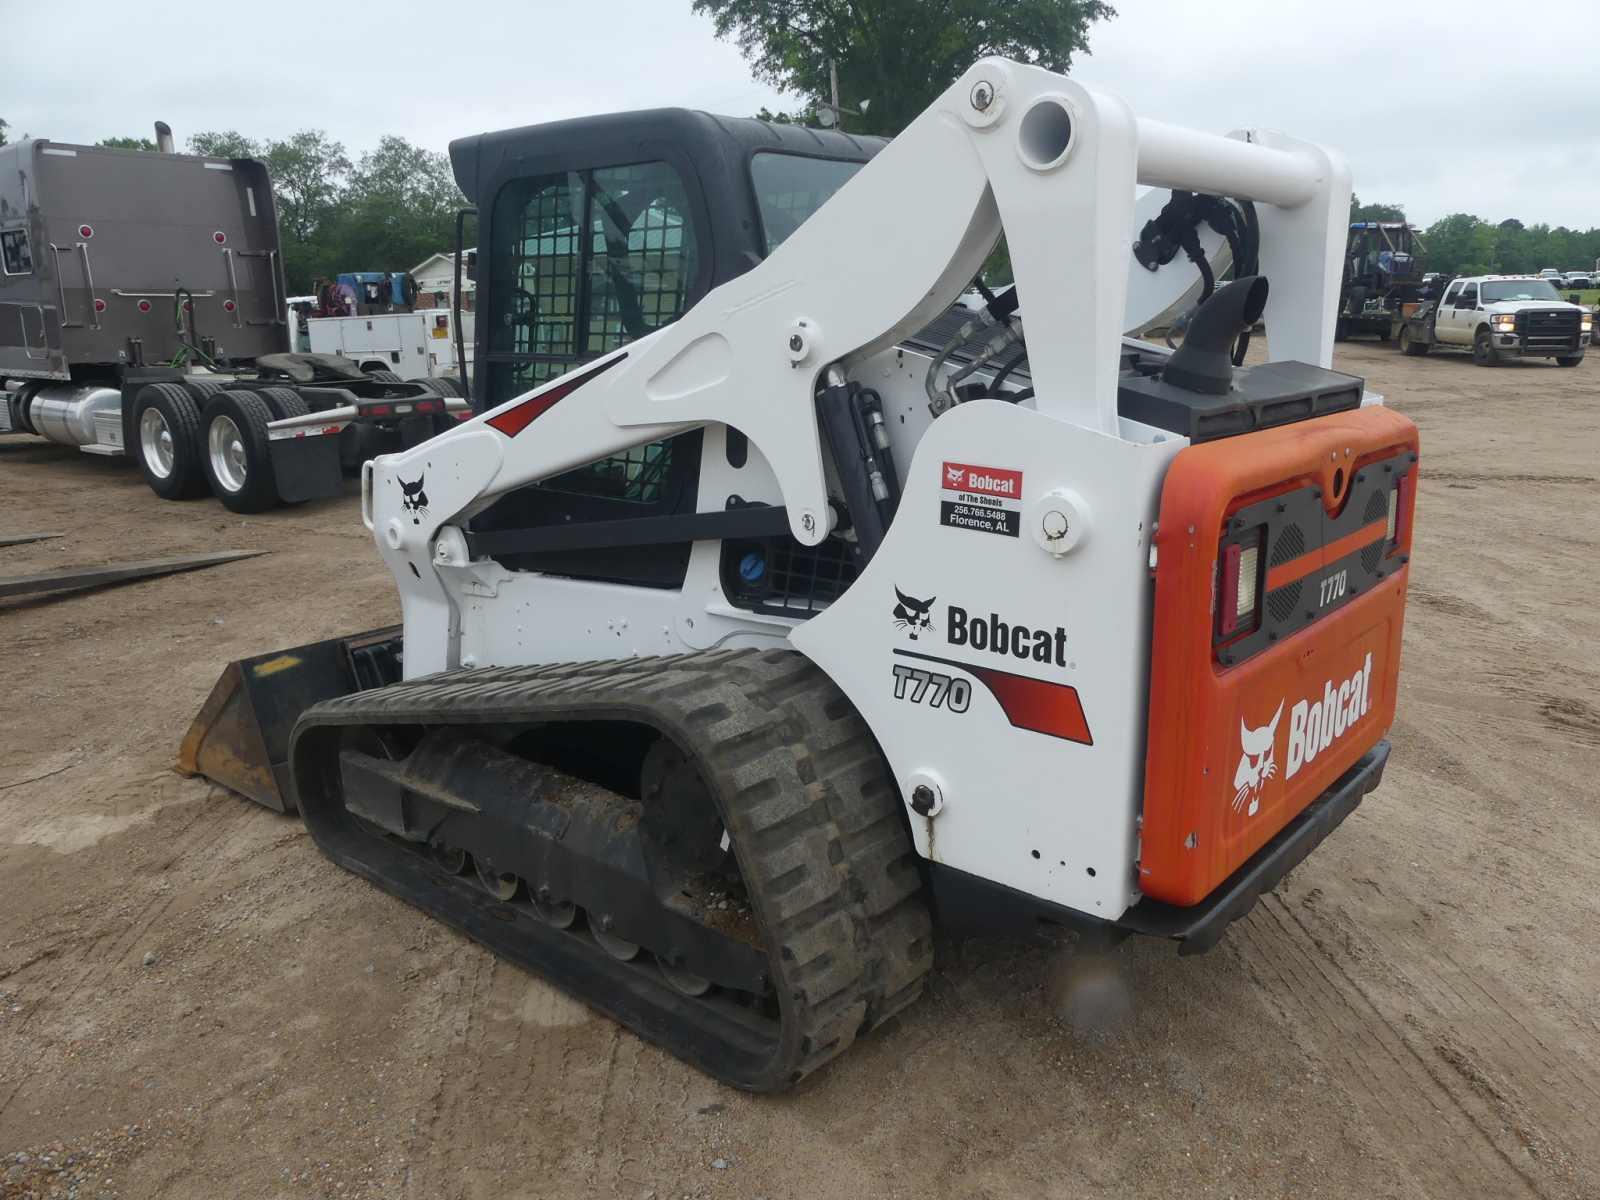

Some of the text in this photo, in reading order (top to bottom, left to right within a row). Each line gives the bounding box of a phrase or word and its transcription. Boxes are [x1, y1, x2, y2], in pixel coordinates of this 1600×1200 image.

[966, 495, 979, 504] The
[979, 496, 1003, 507] Shoals
[968, 473, 1014, 493] Bobcat
[950, 514, 1010, 533] Florence, AL
[1319, 569, 1348, 608] T770
[947, 605, 1067, 668] Bobcat
[892, 664, 972, 714] T770
[1285, 651, 1373, 780] Bobcat
